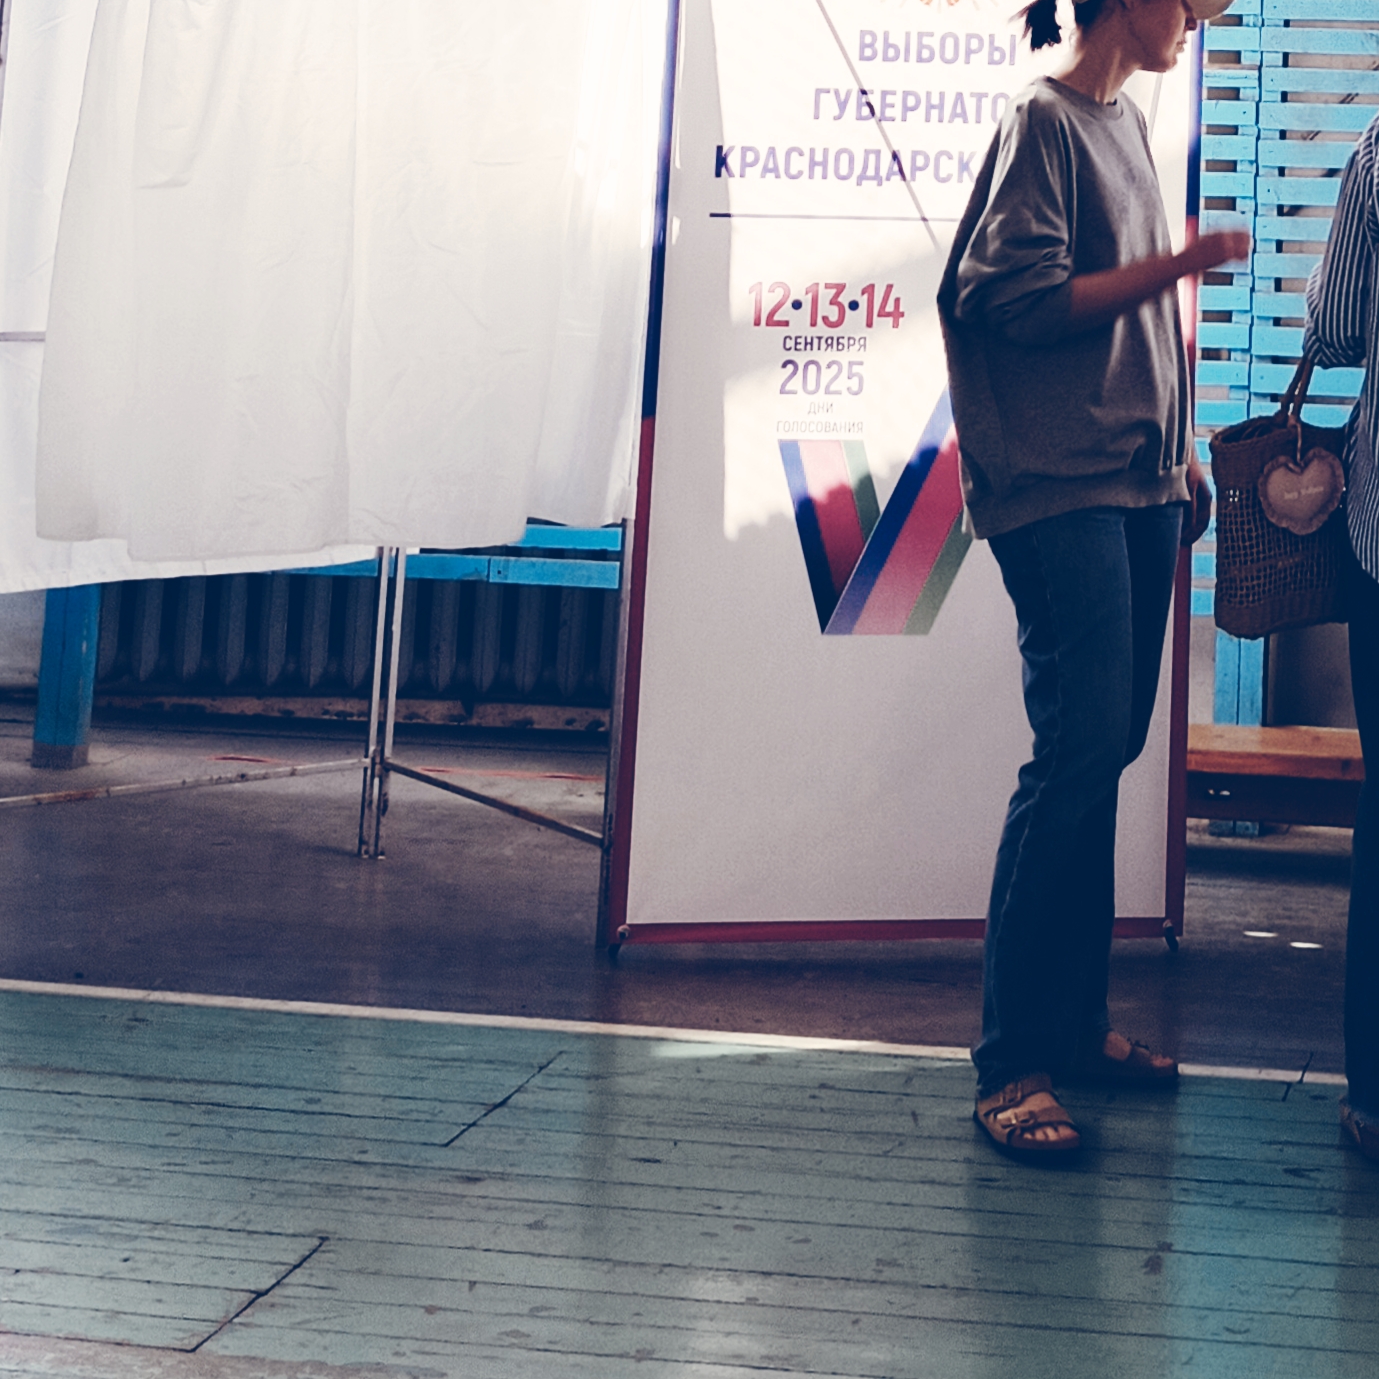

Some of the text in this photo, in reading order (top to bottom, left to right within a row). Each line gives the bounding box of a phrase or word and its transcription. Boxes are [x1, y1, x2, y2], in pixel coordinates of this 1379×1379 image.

[858, 29, 1017, 66] ВЫБОРЫ
[714, 144, 978, 187] КРАСНОДАРСК
[782, 334, 868, 352] СЕНТЯБРЯ
[779, 358, 865, 396] 2025
[807, 401, 834, 415] ДНИ
[776, 420, 864, 433] ГОЛОСОВАНИЯ
